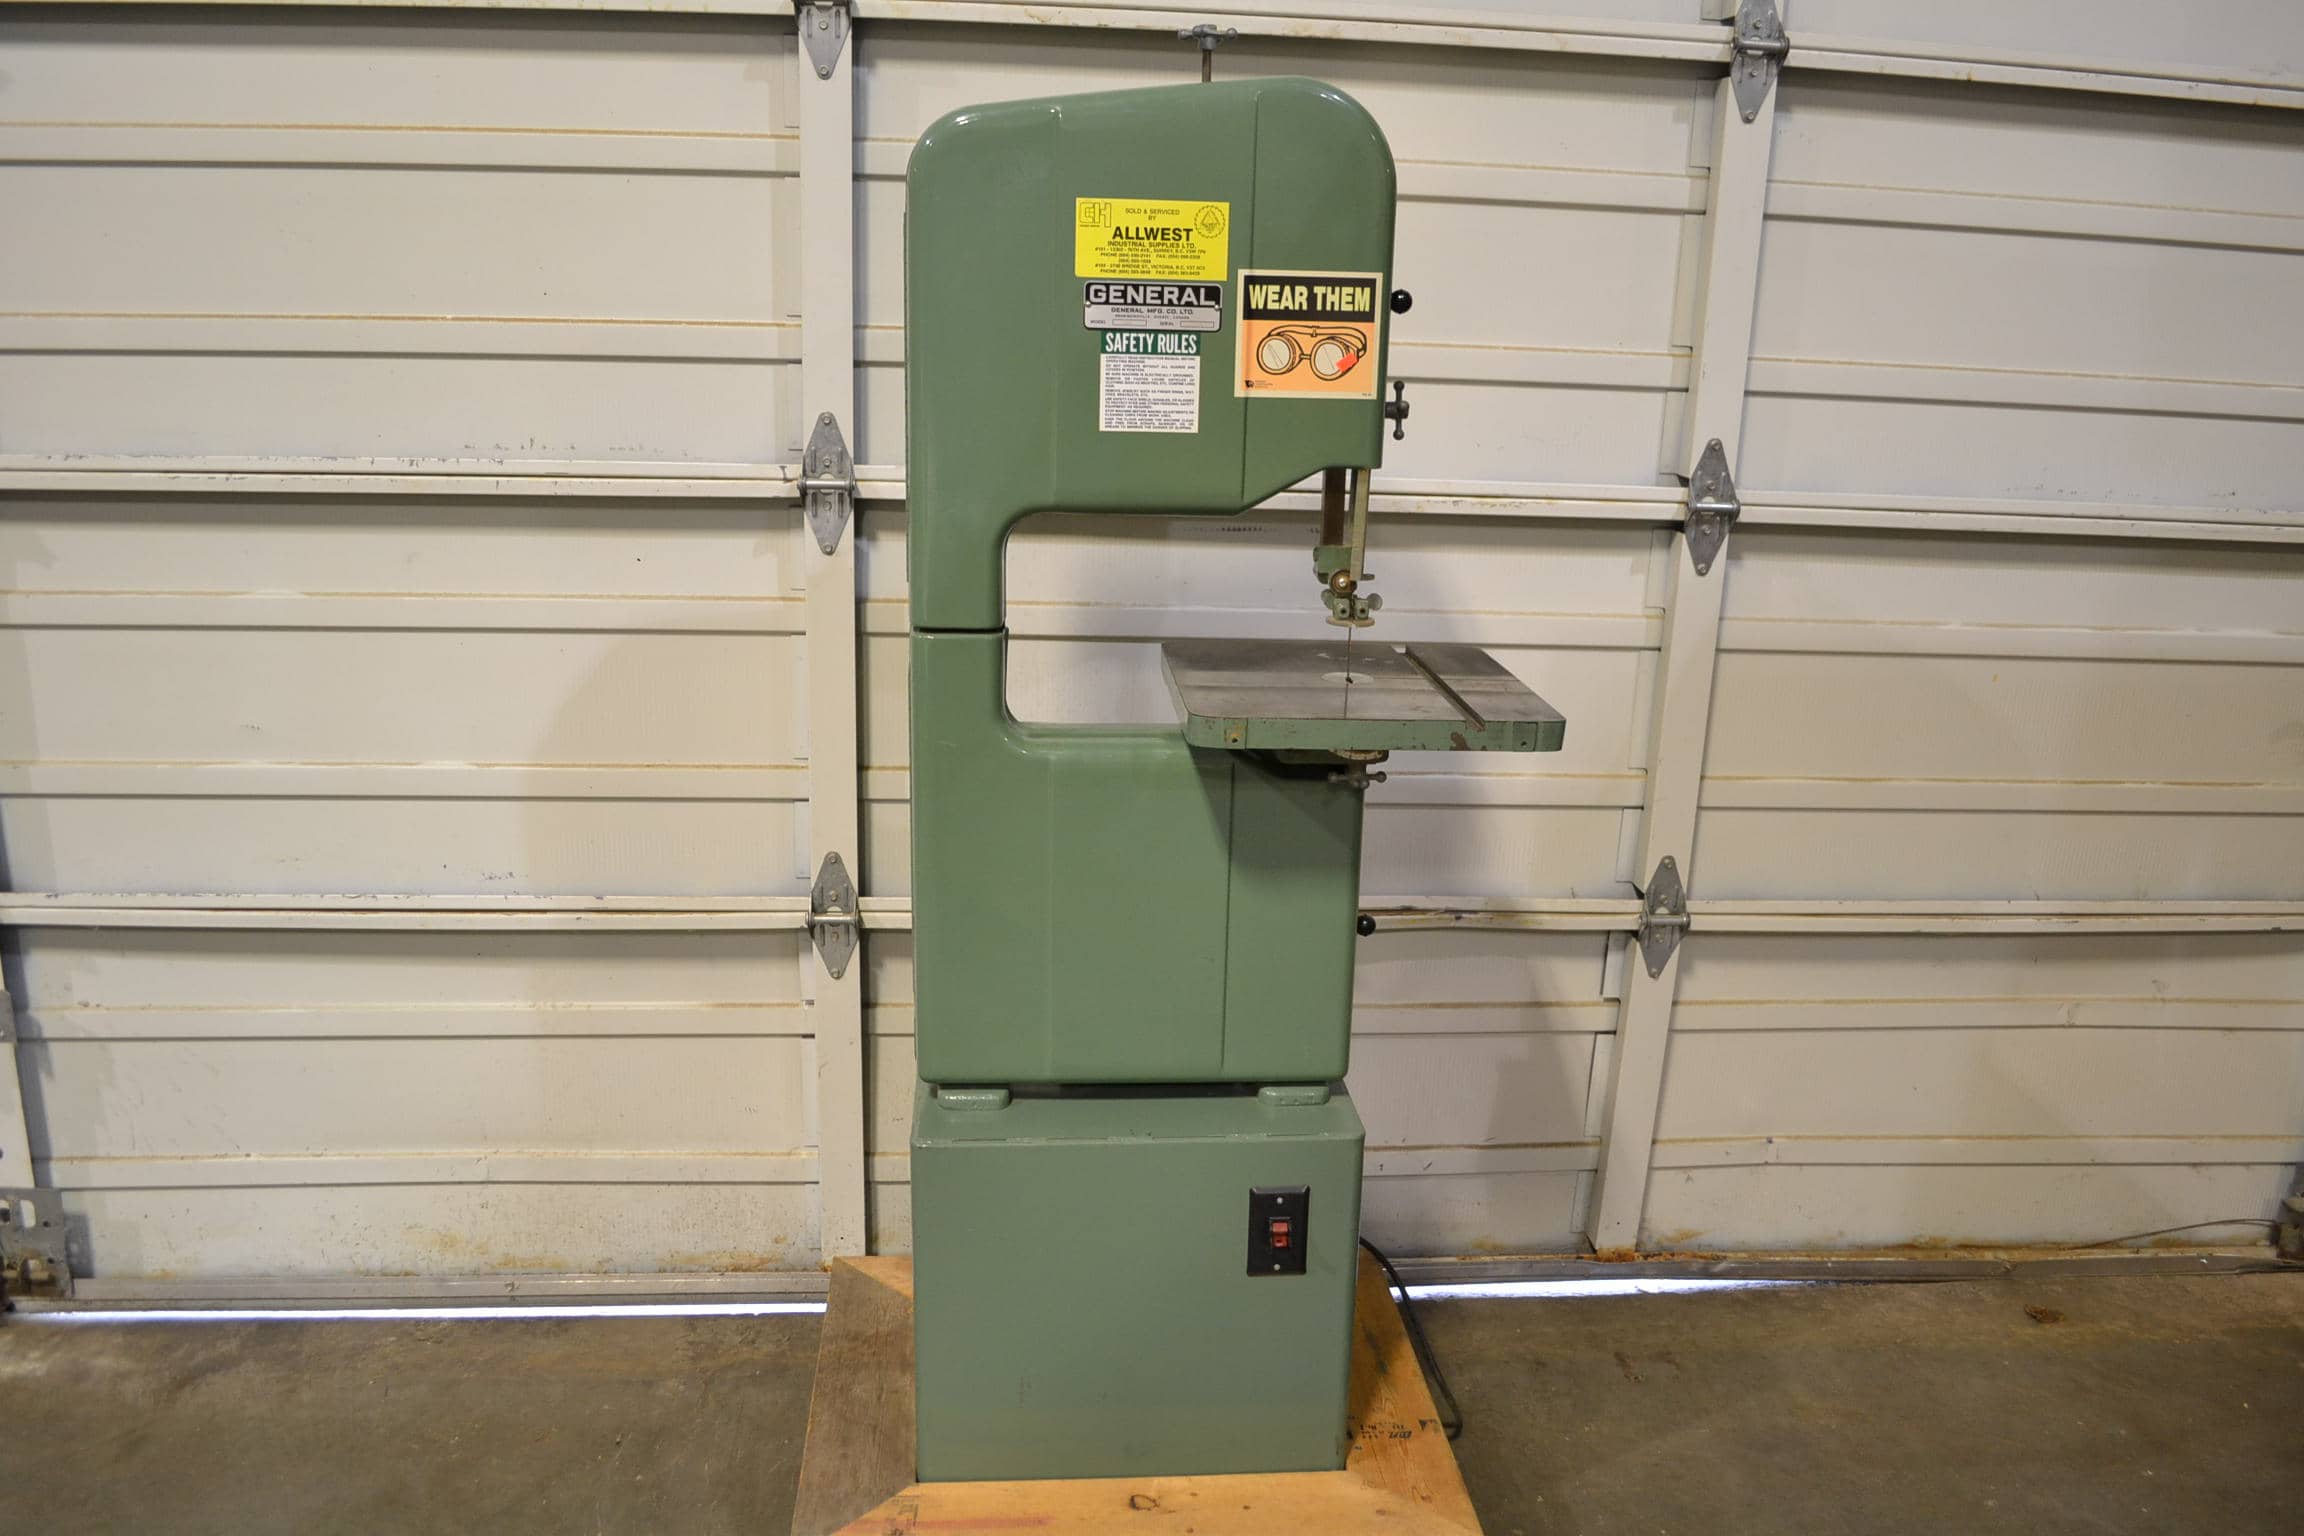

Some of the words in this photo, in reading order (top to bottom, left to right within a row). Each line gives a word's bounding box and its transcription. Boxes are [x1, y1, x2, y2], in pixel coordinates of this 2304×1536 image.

[1112, 226, 1194, 242] ALLWEST
[1089, 284, 1216, 306] GENERAL
[1248, 284, 1309, 311] WEAR
[1313, 286, 1371, 312] THEM
[1105, 332, 1156, 353] SAFETY
[1158, 333, 1198, 354] RULES
